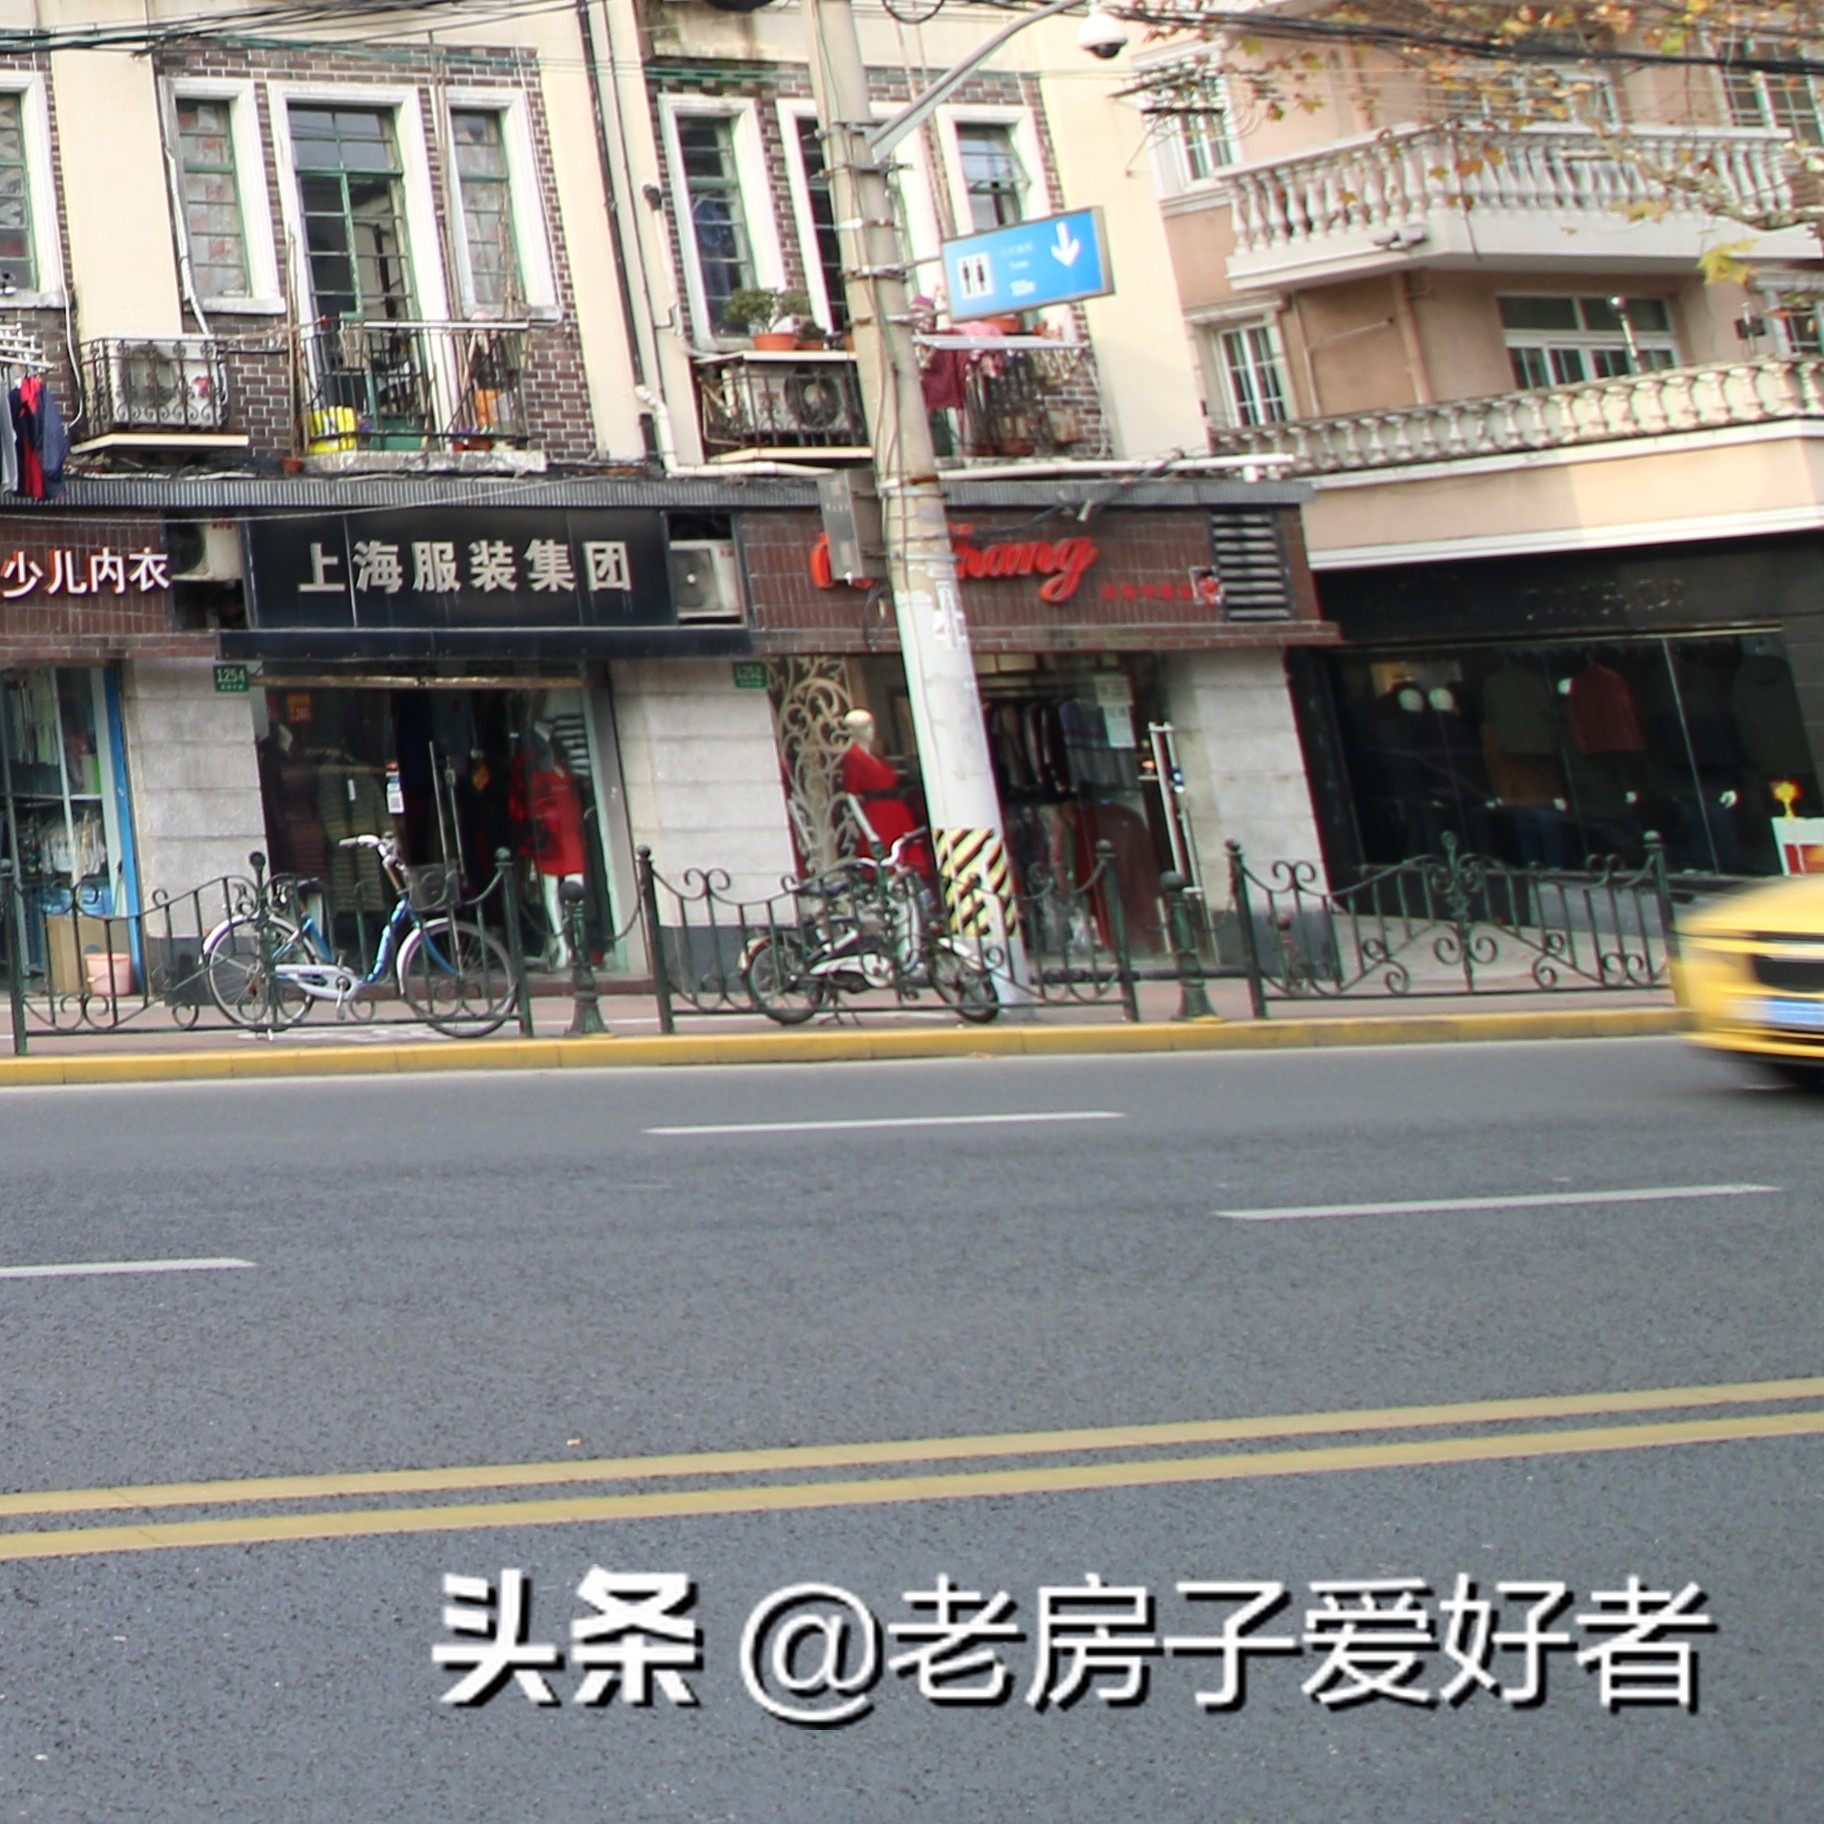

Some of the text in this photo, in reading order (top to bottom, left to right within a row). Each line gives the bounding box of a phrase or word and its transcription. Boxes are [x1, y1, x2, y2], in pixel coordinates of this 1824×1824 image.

[298, 539, 632, 593] 上海服装集团
[216, 667, 246, 683] 1254
